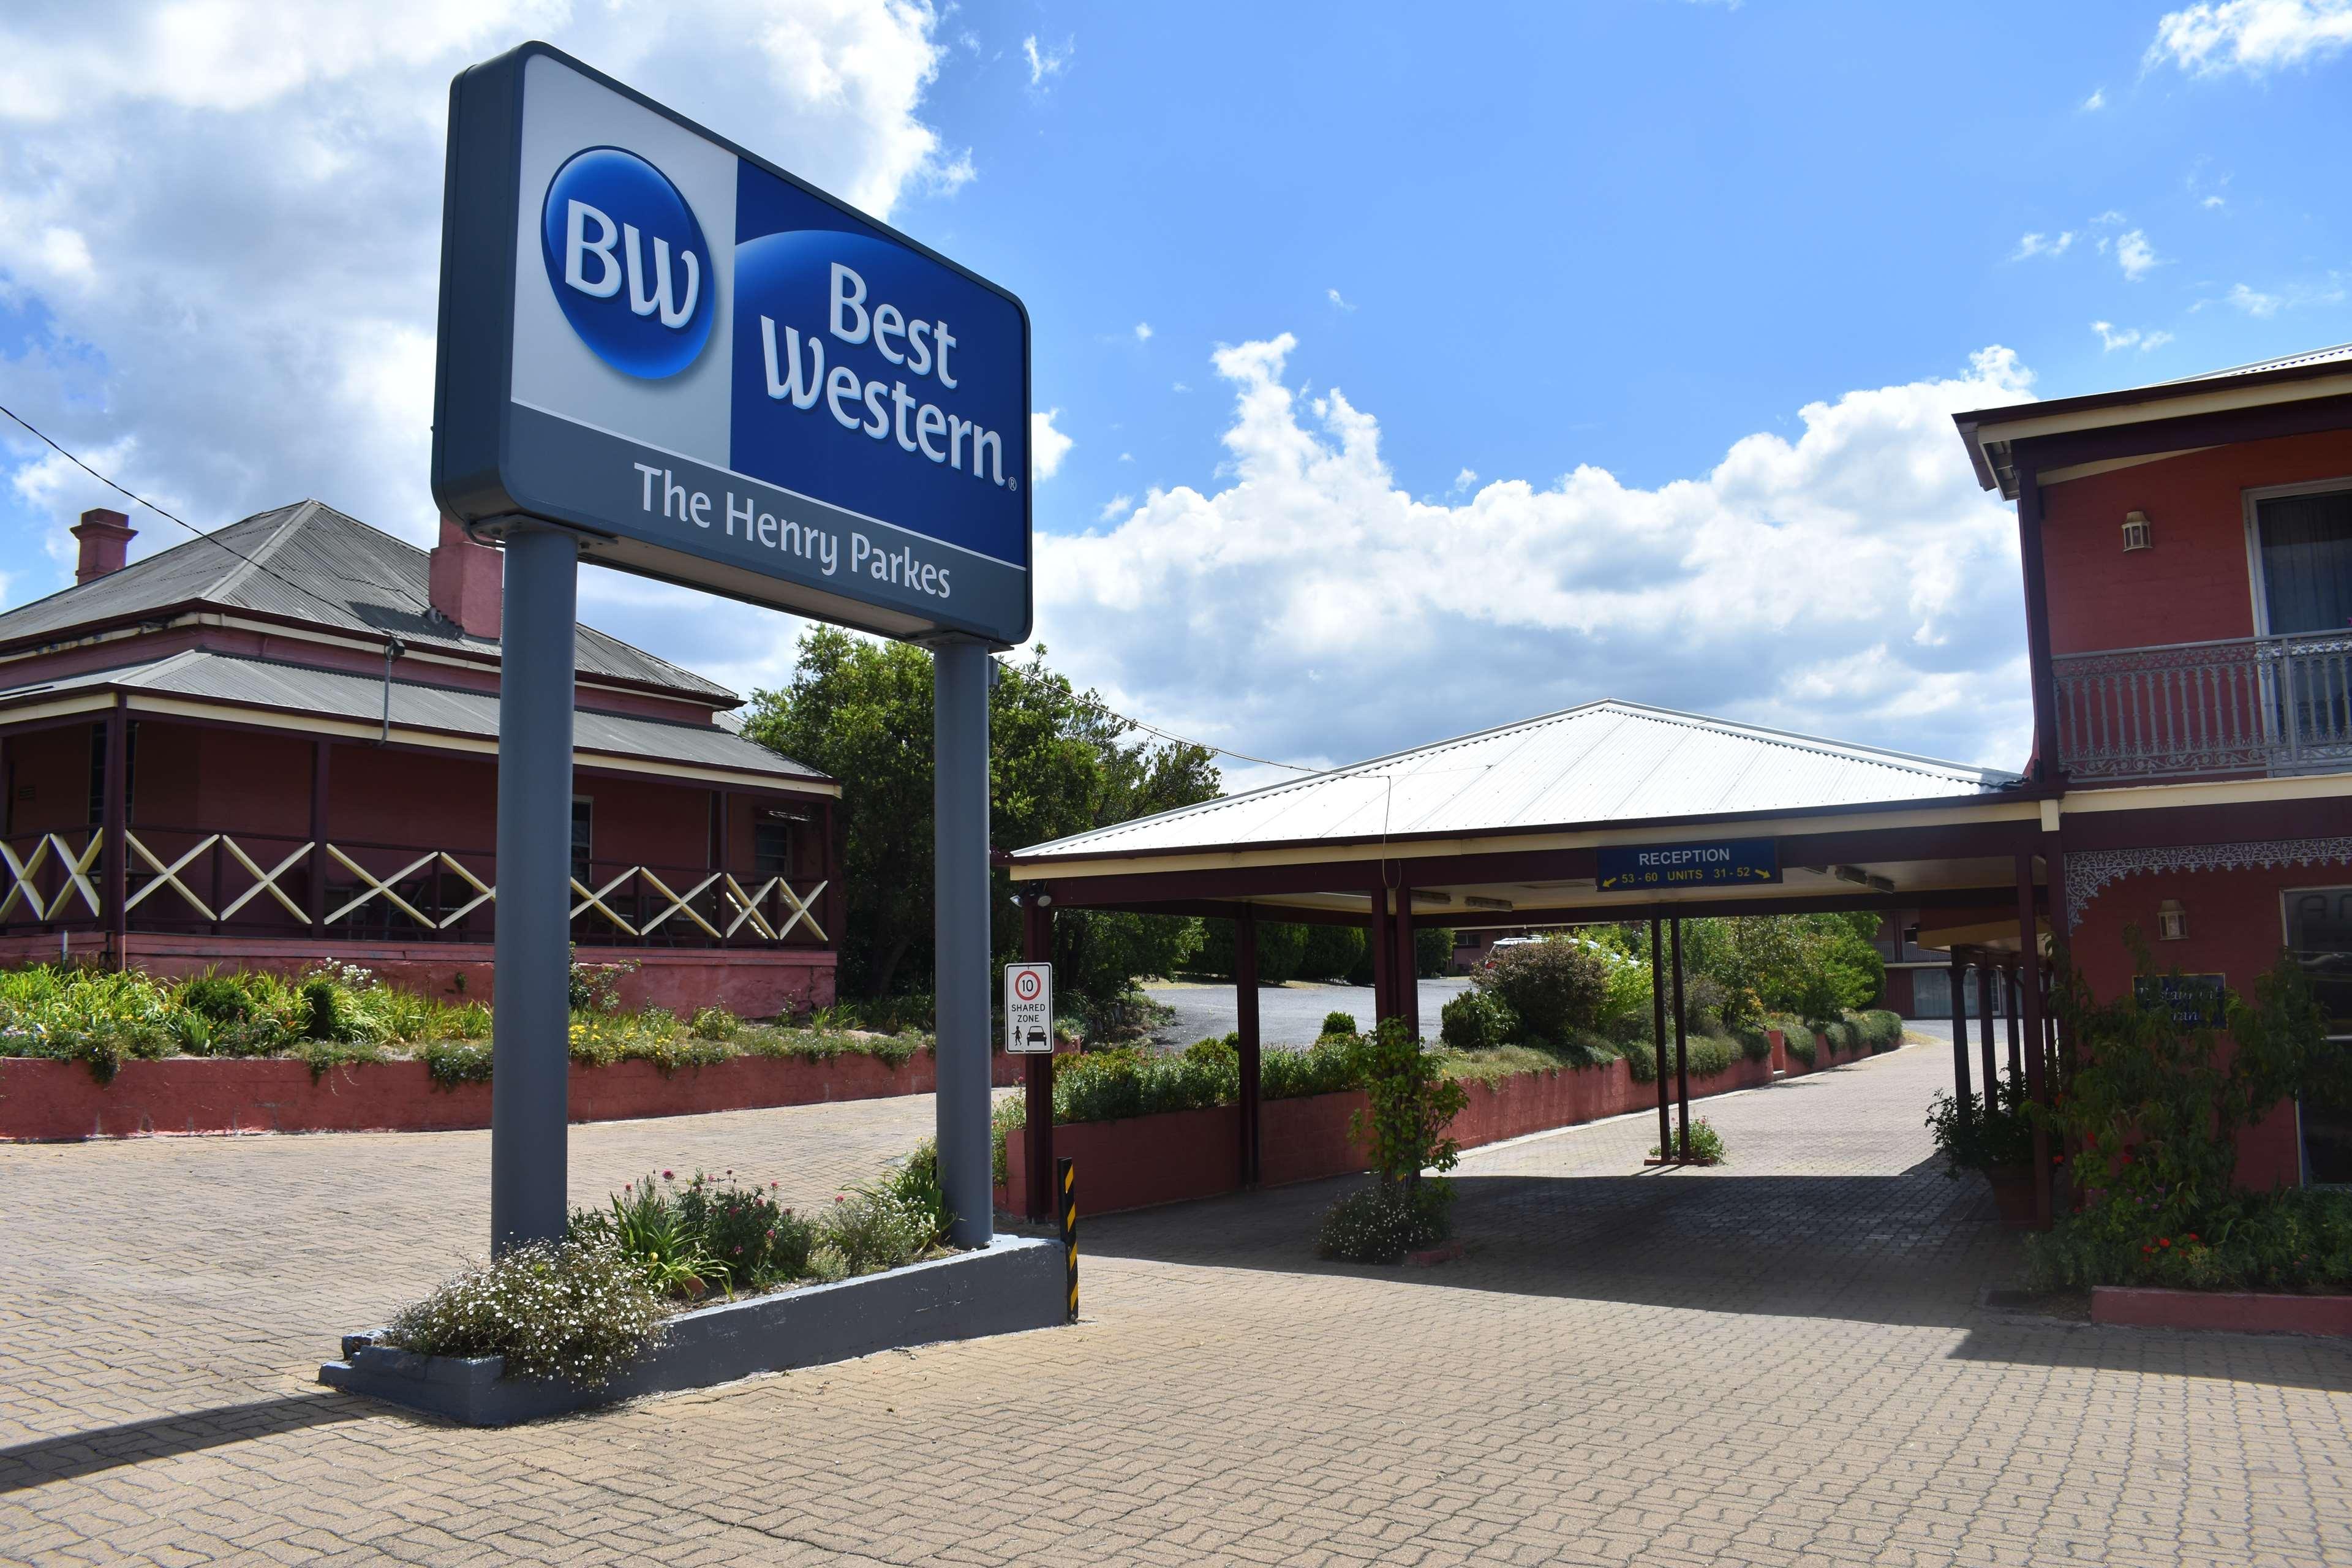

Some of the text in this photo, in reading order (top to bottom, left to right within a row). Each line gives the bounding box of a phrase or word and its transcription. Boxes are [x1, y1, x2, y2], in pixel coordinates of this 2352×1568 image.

[565, 198, 699, 329] BW
[830, 262, 957, 389] Best
[634, 462, 950, 598] The Henry Parkes
[1638, 848, 1730, 866] RECEPTION
[1621, 873, 1635, 883] 53
[1645, 872, 1658, 882] 60
[1667, 870, 1703, 881] UNITS
[1714, 869, 1726, 878] 31
[1736, 867, 1750, 876] 52
[1022, 979, 1034, 992] 10
[1011, 1004, 1046, 1012] SHARED
[1017, 1014, 1039, 1023] ZONE
